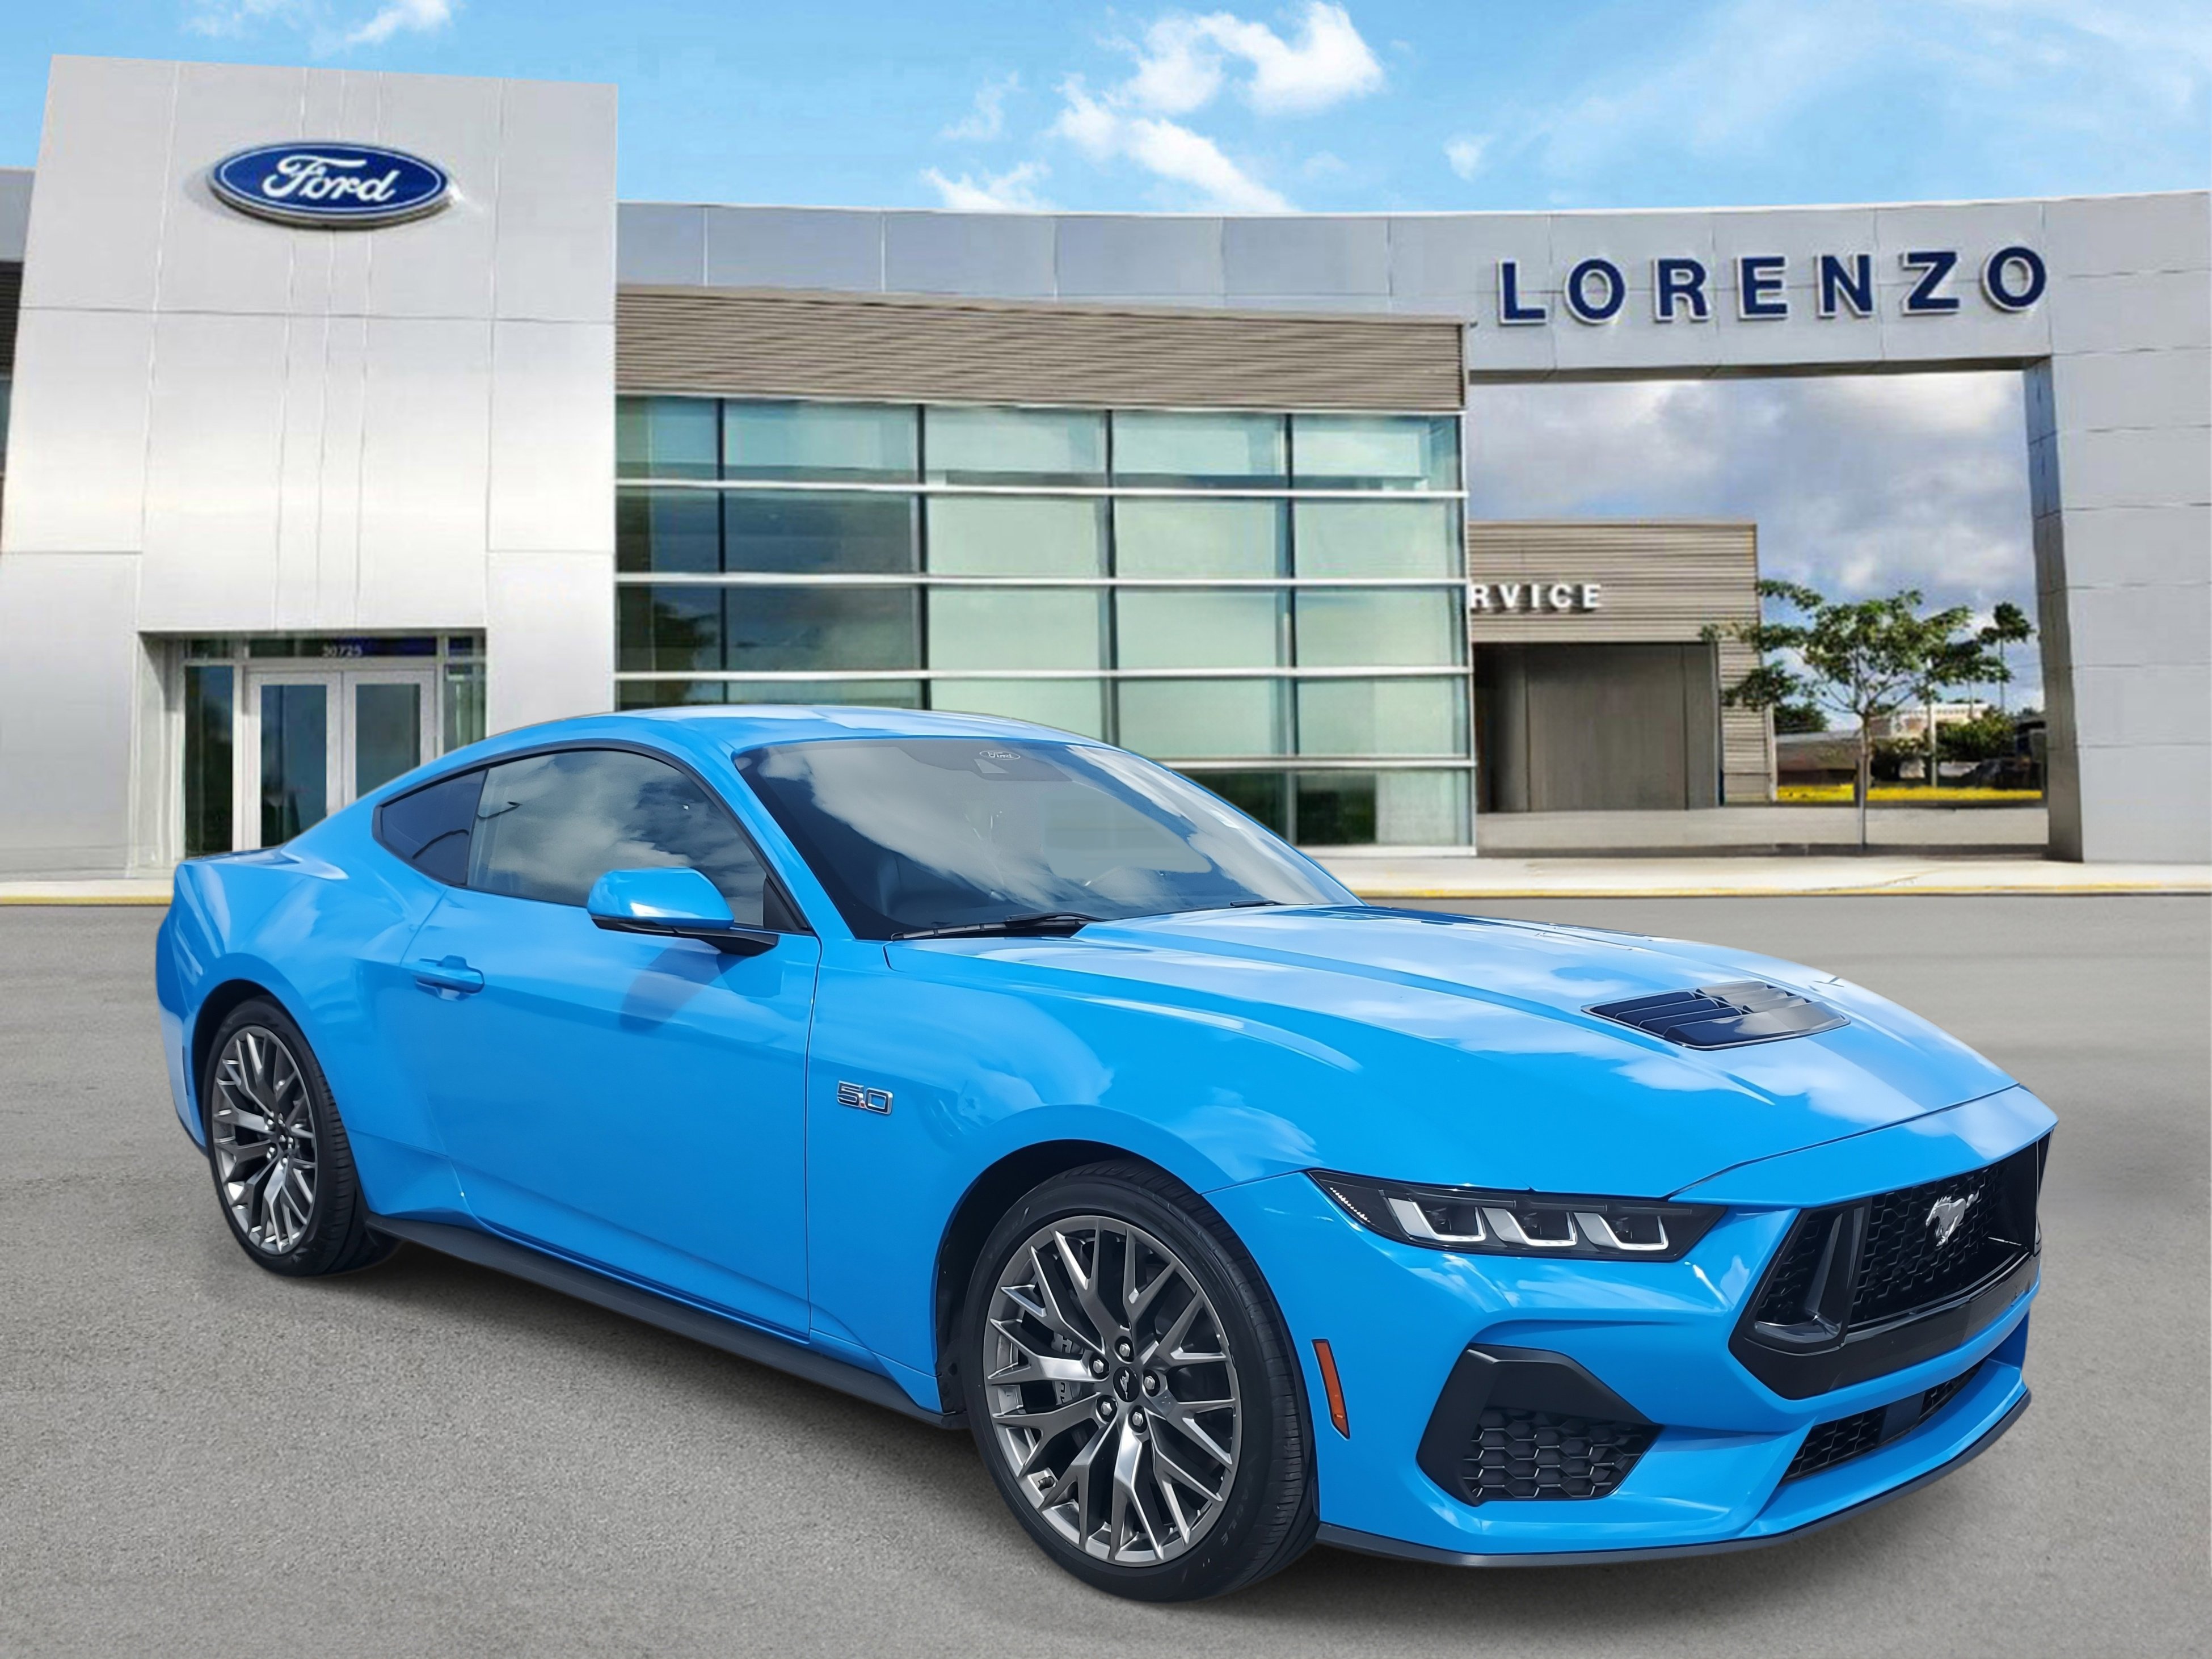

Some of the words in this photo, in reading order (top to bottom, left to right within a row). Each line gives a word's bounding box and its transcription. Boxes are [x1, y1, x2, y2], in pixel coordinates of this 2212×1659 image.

[262, 154, 399, 201] Ford
[1498, 246, 2047, 323] LORENZO
[837, 1080, 894, 1115] 5.0
